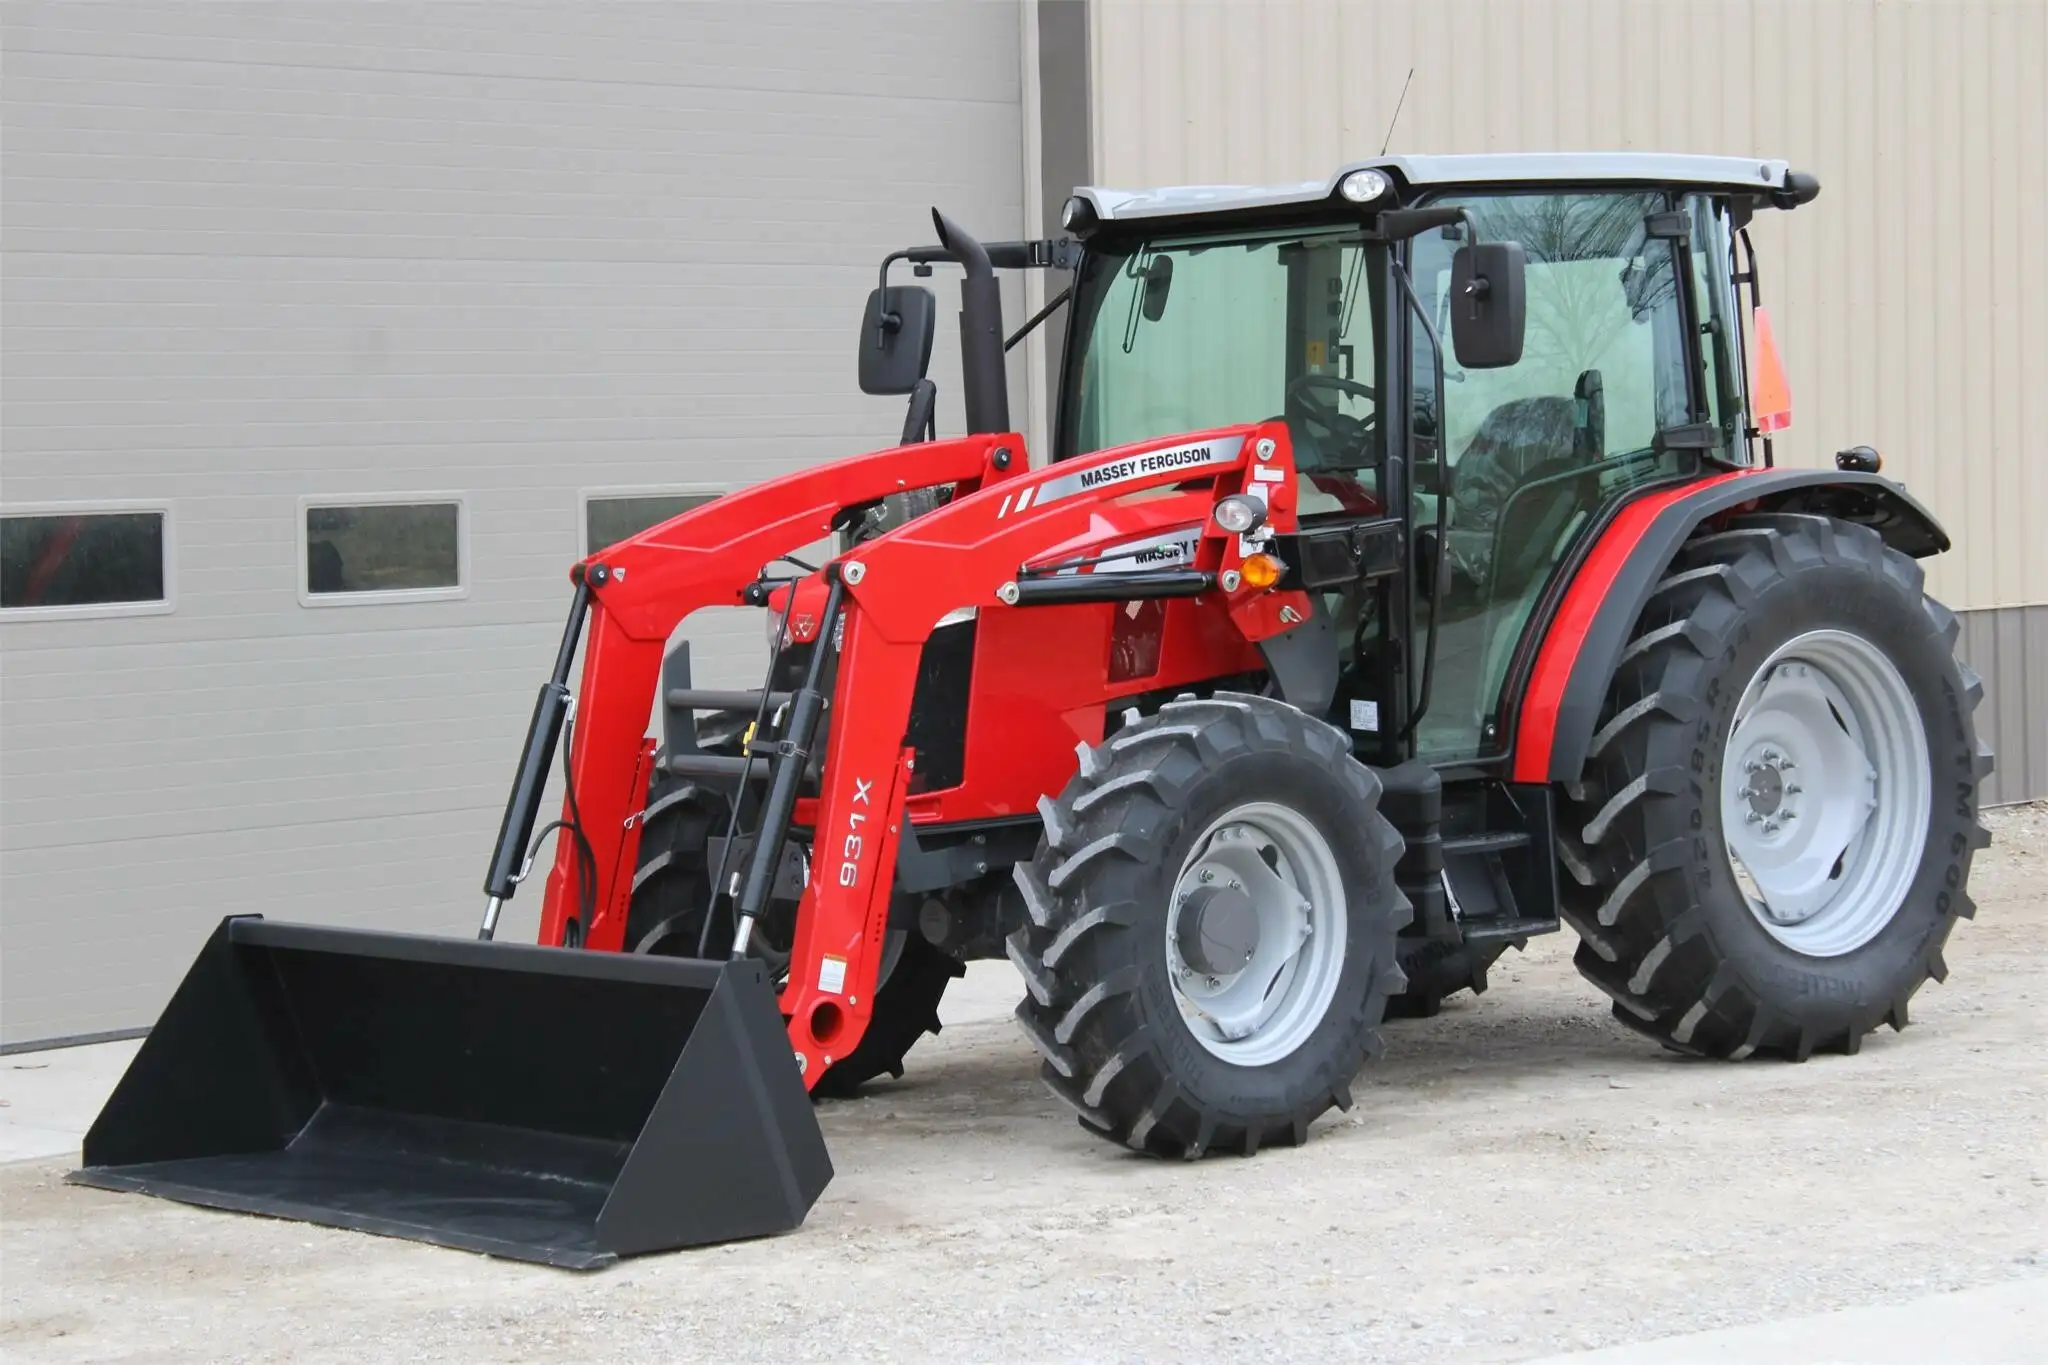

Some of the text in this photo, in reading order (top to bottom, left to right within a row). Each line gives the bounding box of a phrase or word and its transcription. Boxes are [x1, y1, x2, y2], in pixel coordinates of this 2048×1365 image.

[1080, 447, 1212, 488] MASSEY FERGUSON
[840, 777, 873, 887] 931X
